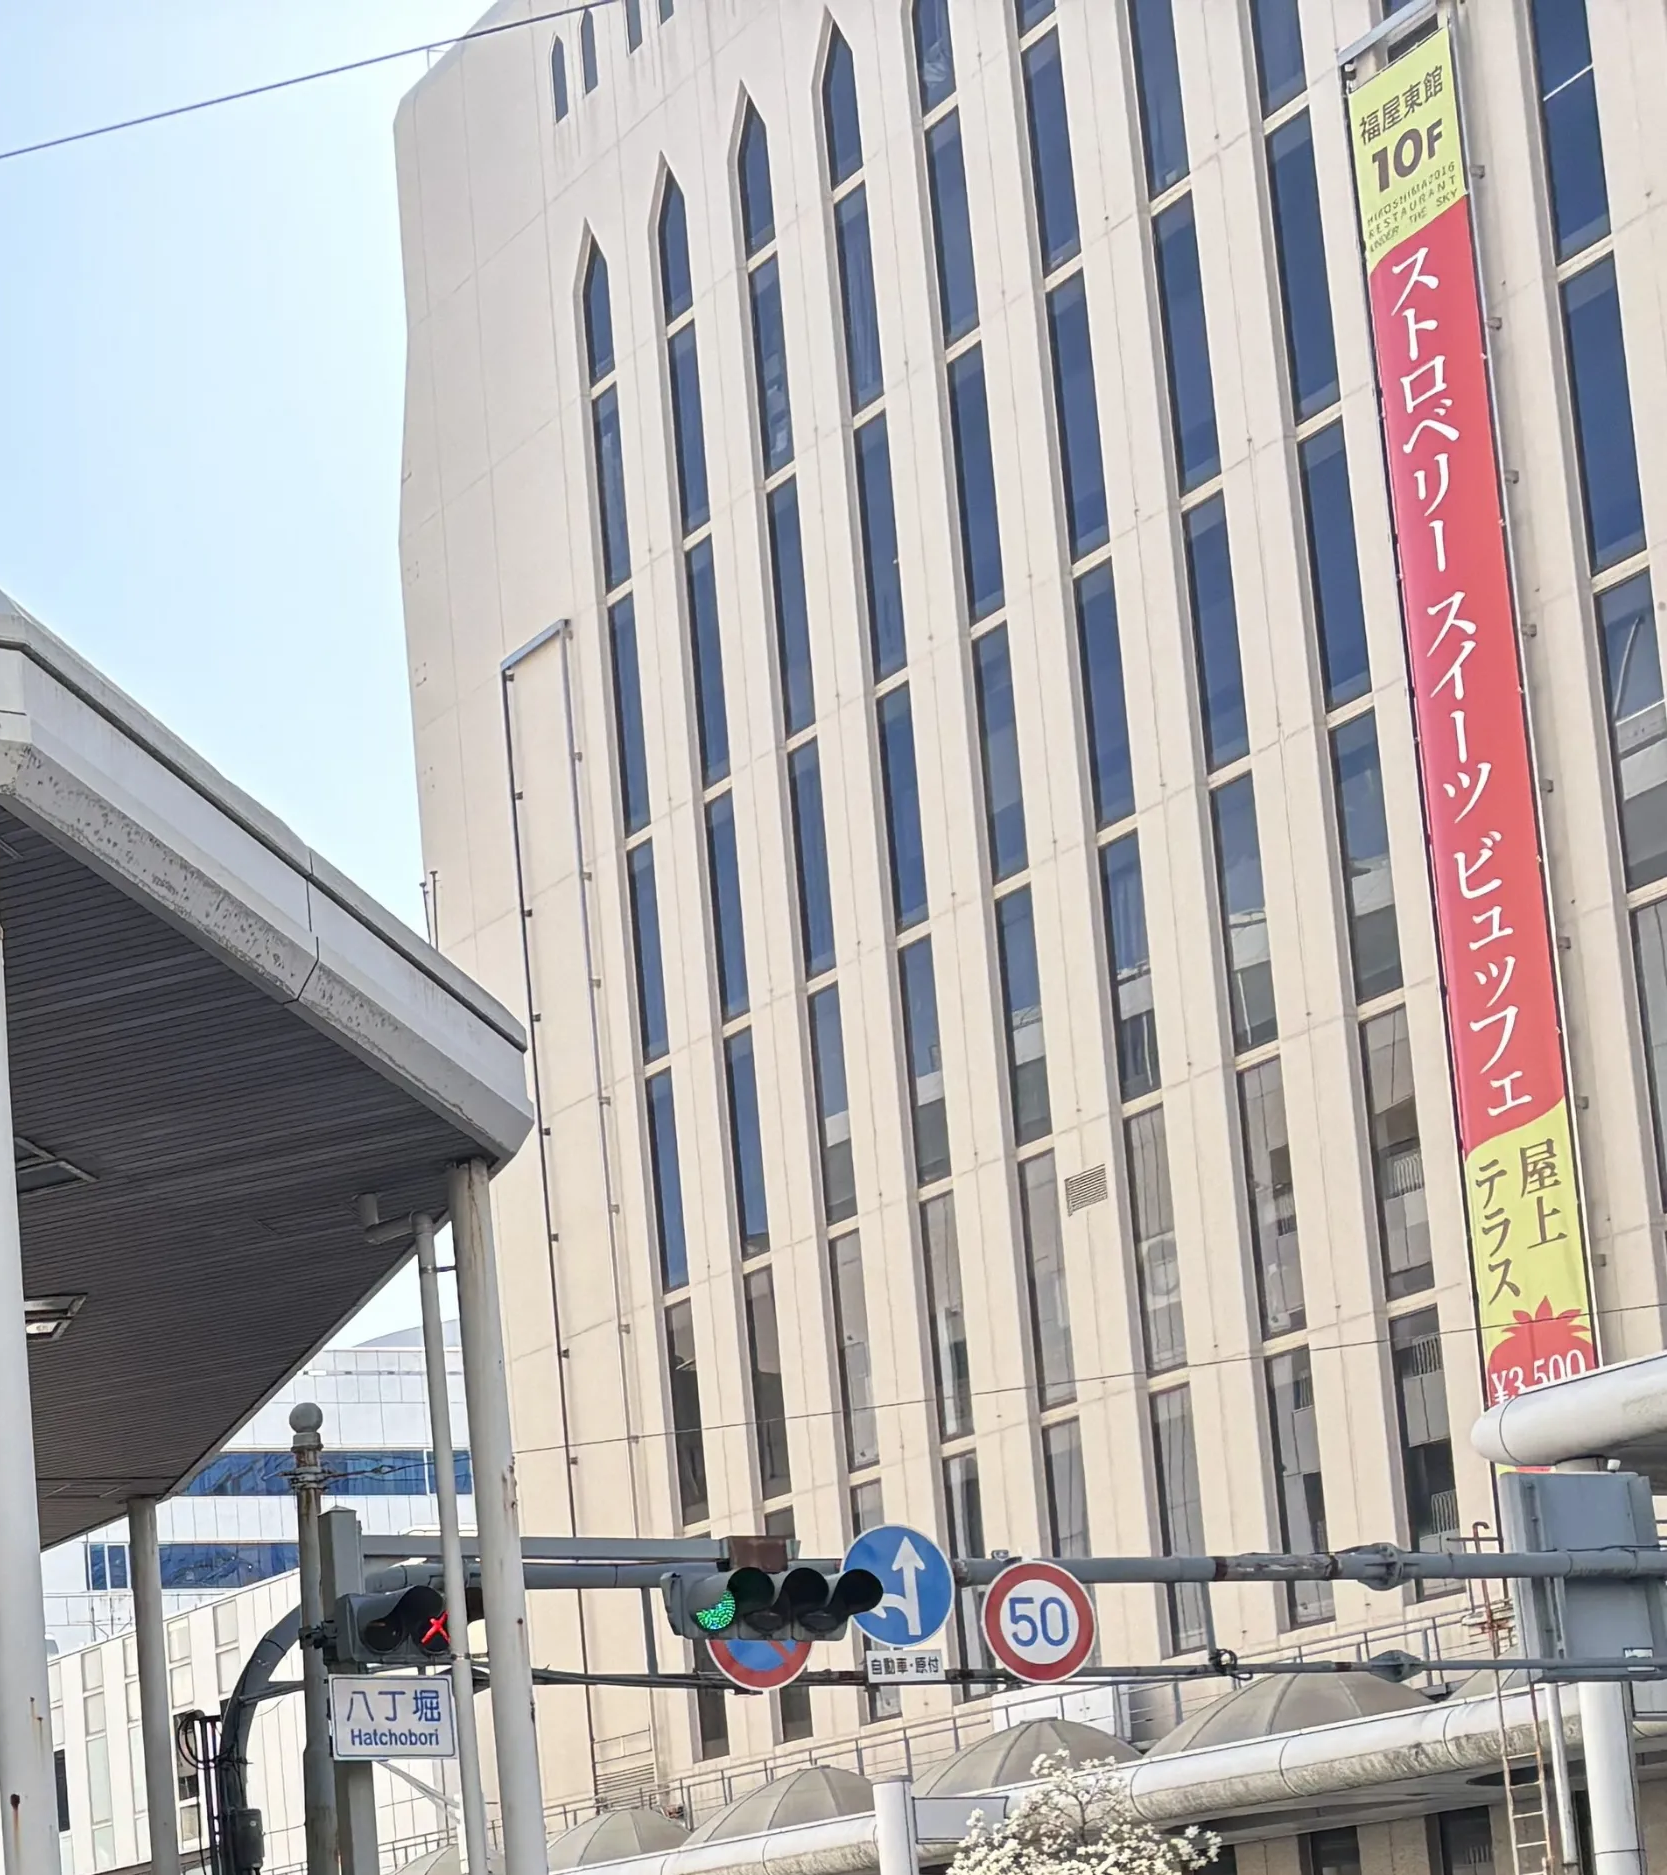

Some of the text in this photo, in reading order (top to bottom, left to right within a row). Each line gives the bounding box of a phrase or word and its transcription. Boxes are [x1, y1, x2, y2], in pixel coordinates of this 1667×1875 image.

[1359, 64, 1443, 146] 福屋東館
[1371, 118, 1444, 194] 10F
[1368, 173, 1457, 241] RESTAURANT
[1435, 187, 1459, 209] SKY
[1391, 246, 1533, 1119] ストロベリー スイーツ ビュッフェ
[1519, 1137, 1569, 1250] 屋上
[1475, 1159, 1522, 1306] テラス
[1009, 1596, 1070, 1647] 50
[346, 1689, 442, 1722] 八丁堀
[350, 1728, 441, 1746] Hatchobori
